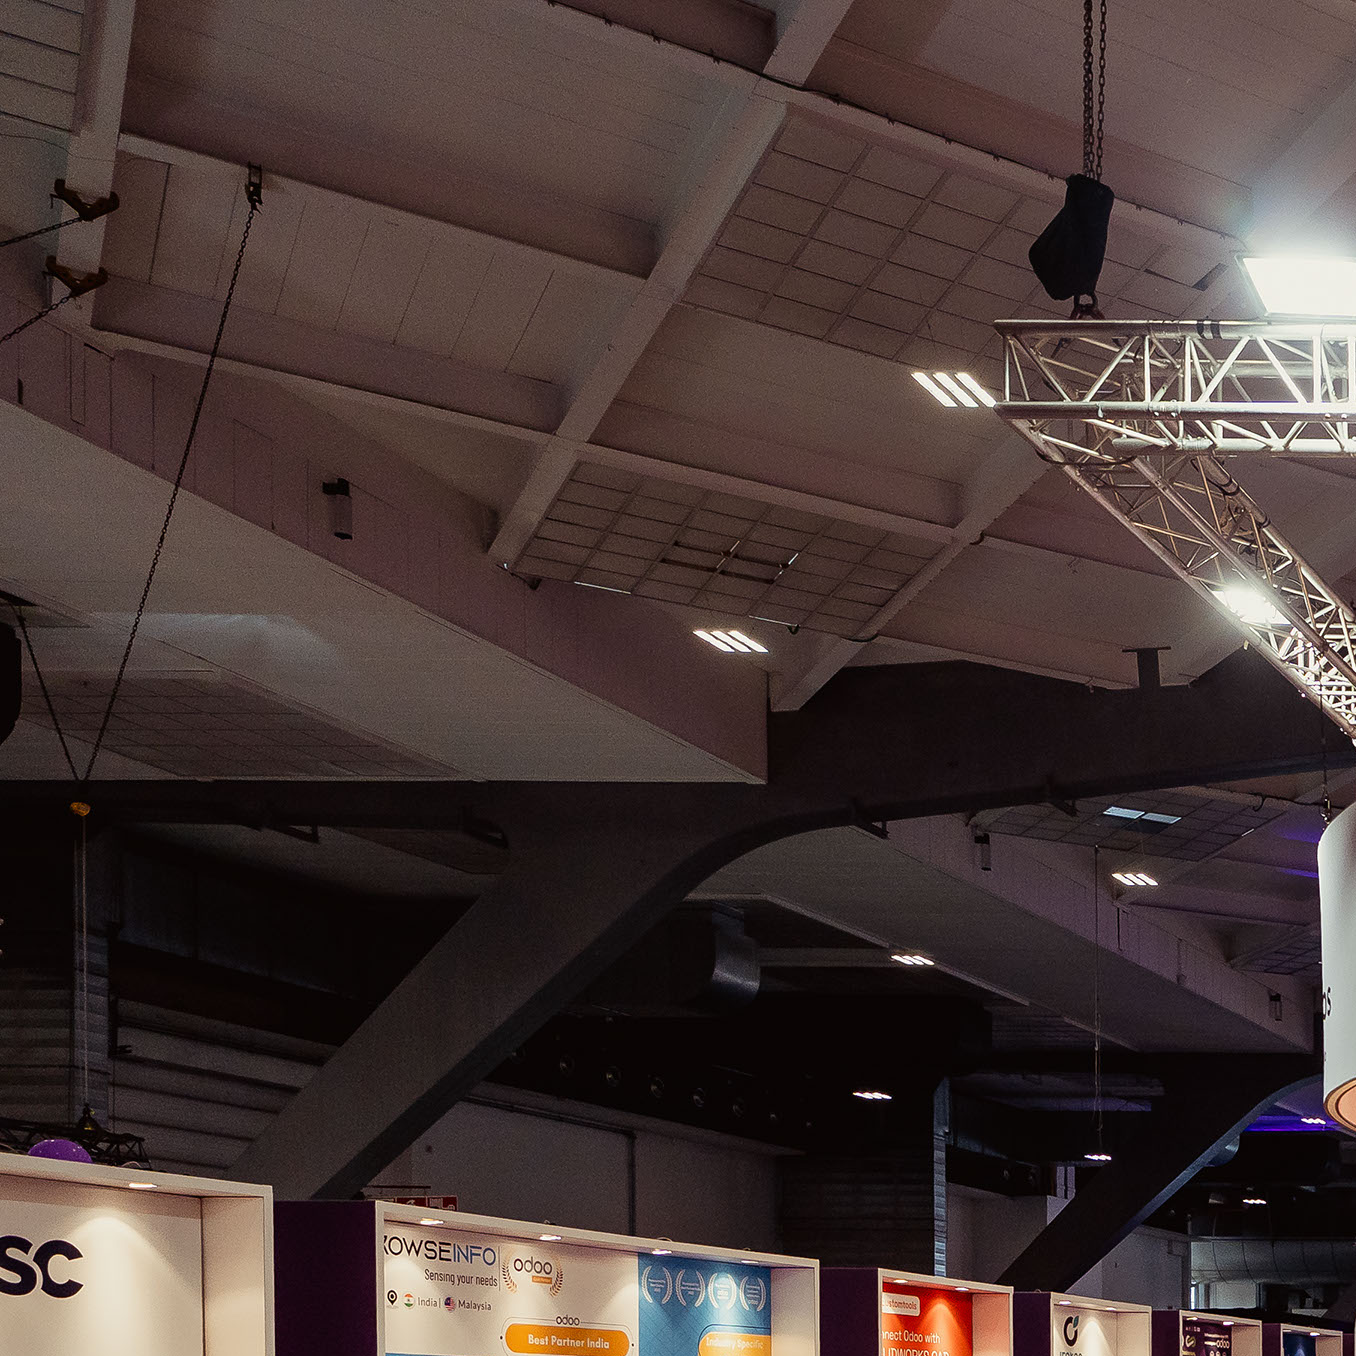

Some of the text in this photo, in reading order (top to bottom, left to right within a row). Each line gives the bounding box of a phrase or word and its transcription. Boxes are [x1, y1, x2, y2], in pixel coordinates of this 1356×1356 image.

[513, 1256, 553, 1275] odoo
[424, 1268, 498, 1287] Sensing your needs
[458, 1299, 492, 1311] Malaysia
[556, 1315, 580, 1326] odoo
[528, 1333, 610, 1349] Best Partner India
[737, 1338, 763, 1350] Specific
[903, 1329, 924, 1343] Odoo
[925, 1332, 941, 1344] with
